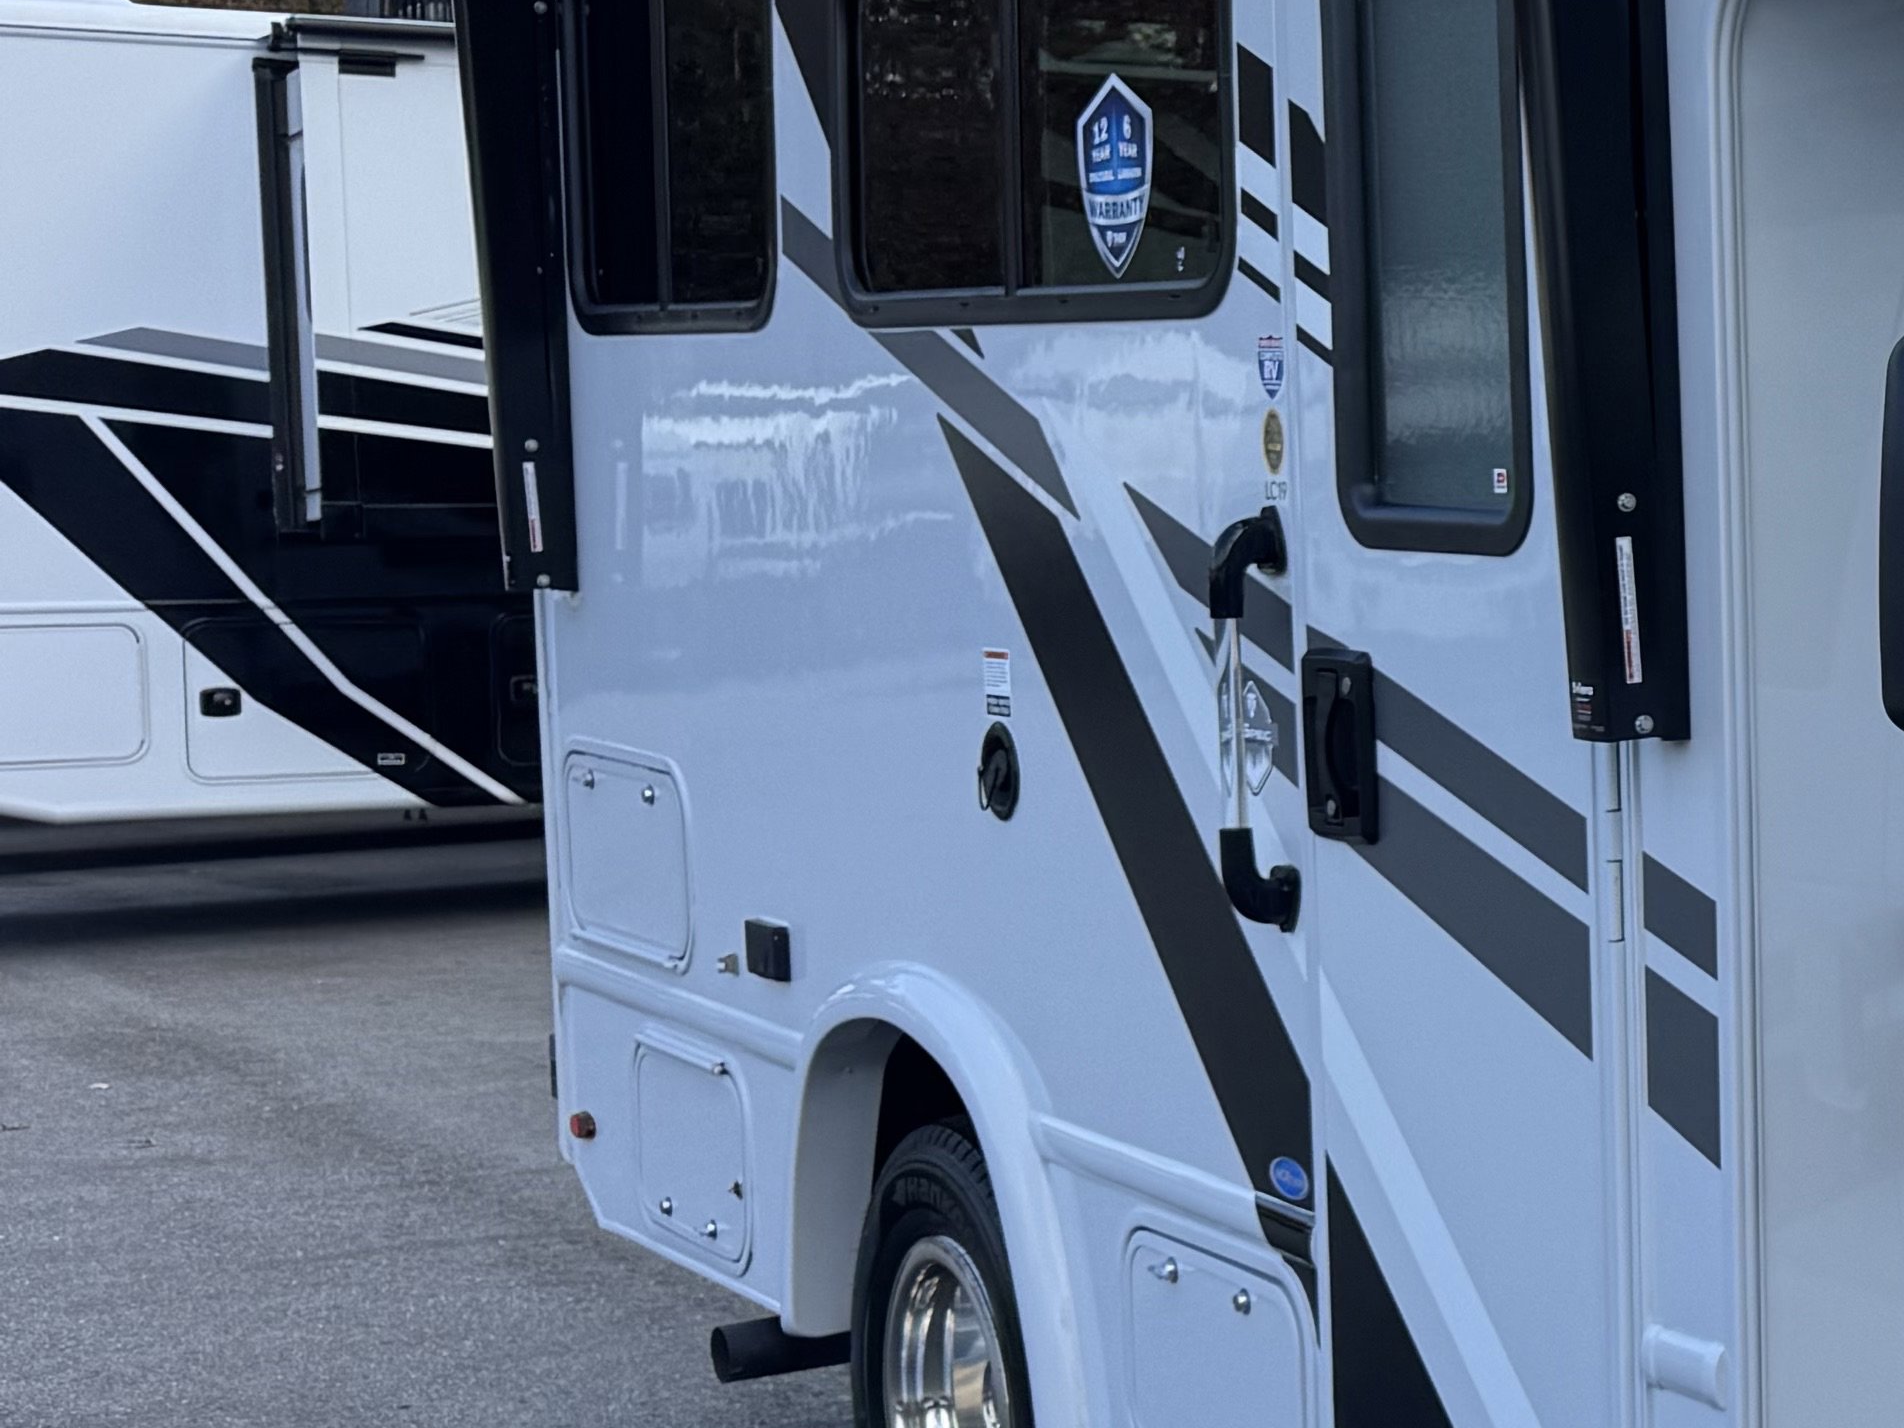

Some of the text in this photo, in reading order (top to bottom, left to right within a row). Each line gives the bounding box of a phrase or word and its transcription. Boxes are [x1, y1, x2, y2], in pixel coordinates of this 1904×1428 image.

[1092, 115, 1132, 145] 12 6
[1092, 142, 1138, 163] YEAR YEAR
[1088, 194, 1145, 222] WARRANTY
